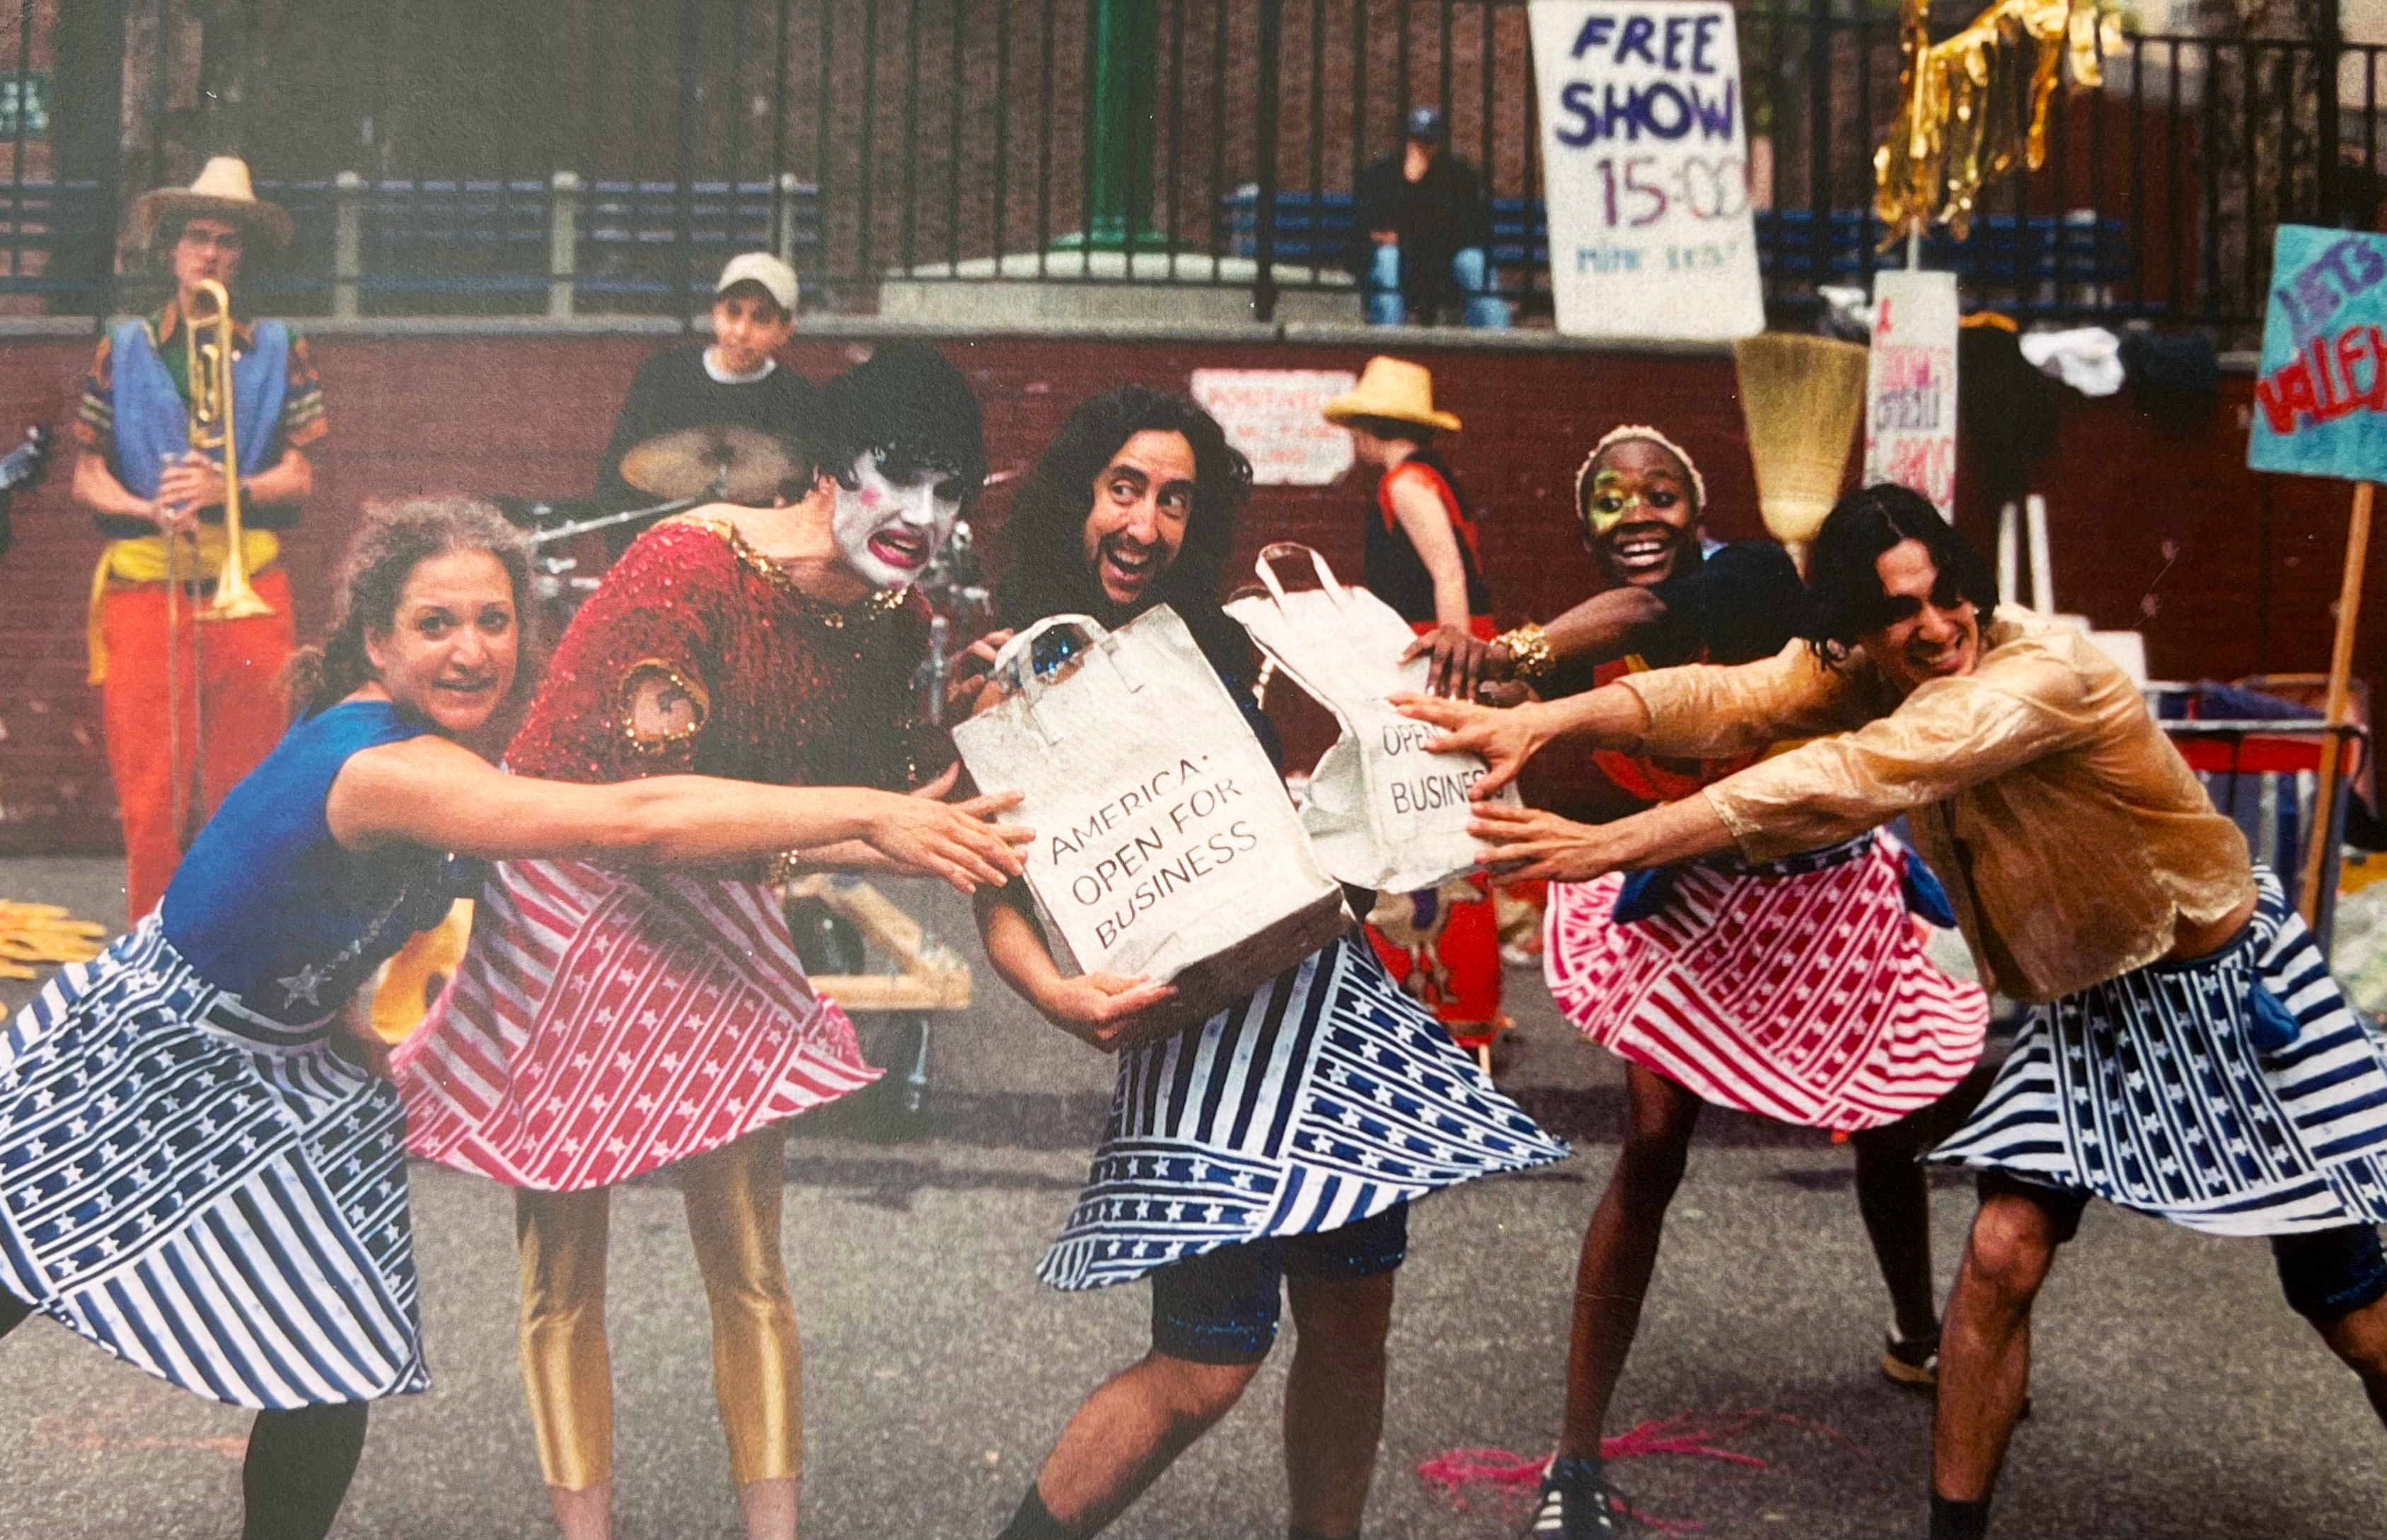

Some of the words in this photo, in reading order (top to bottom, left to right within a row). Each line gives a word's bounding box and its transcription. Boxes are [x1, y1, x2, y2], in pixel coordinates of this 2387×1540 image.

[1571, 13, 1721, 75] FREE
[1554, 77, 1735, 148] SHOW
[1595, 154, 1752, 228] 15:00
[1391, 770, 1504, 814] BUSINE
[1072, 826, 1164, 905] OPEN
[1169, 779, 1243, 834] FOR
[1095, 821, 1257, 949] BUSINESS
